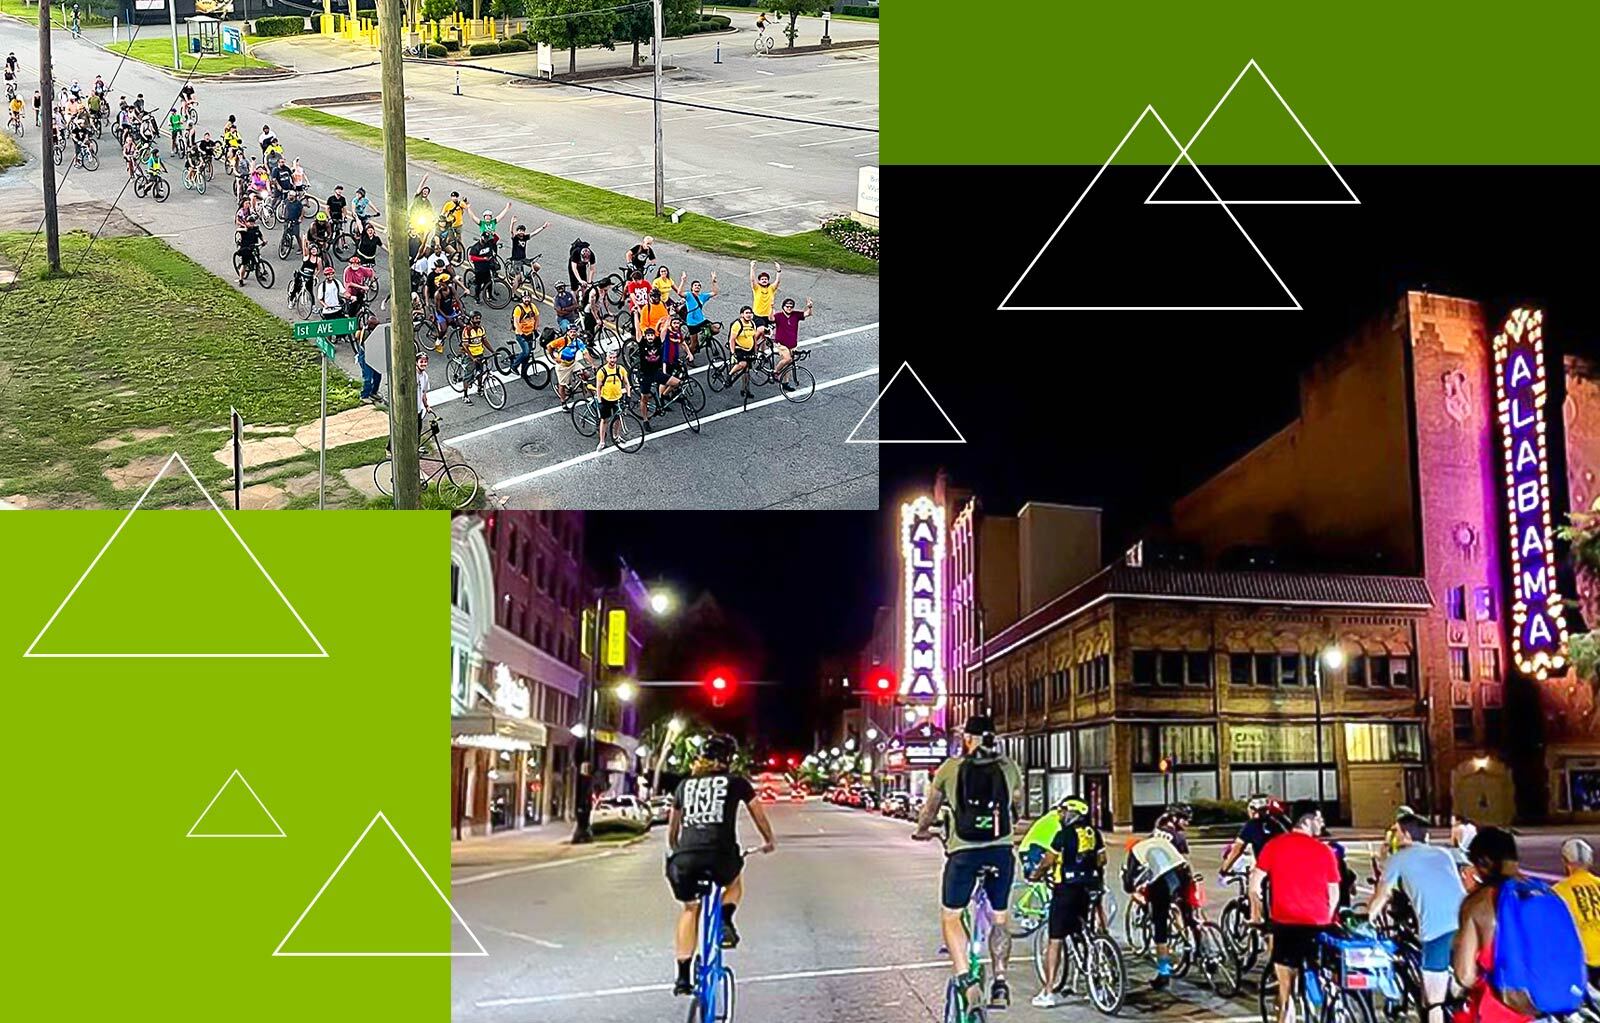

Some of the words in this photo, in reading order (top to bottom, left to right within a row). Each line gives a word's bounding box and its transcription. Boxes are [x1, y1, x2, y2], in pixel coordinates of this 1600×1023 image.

[317, 323, 333, 334] AVE
[348, 321, 355, 331] N
[1510, 355, 1552, 646] ALABAMA
[913, 519, 934, 694] ALABAMA
